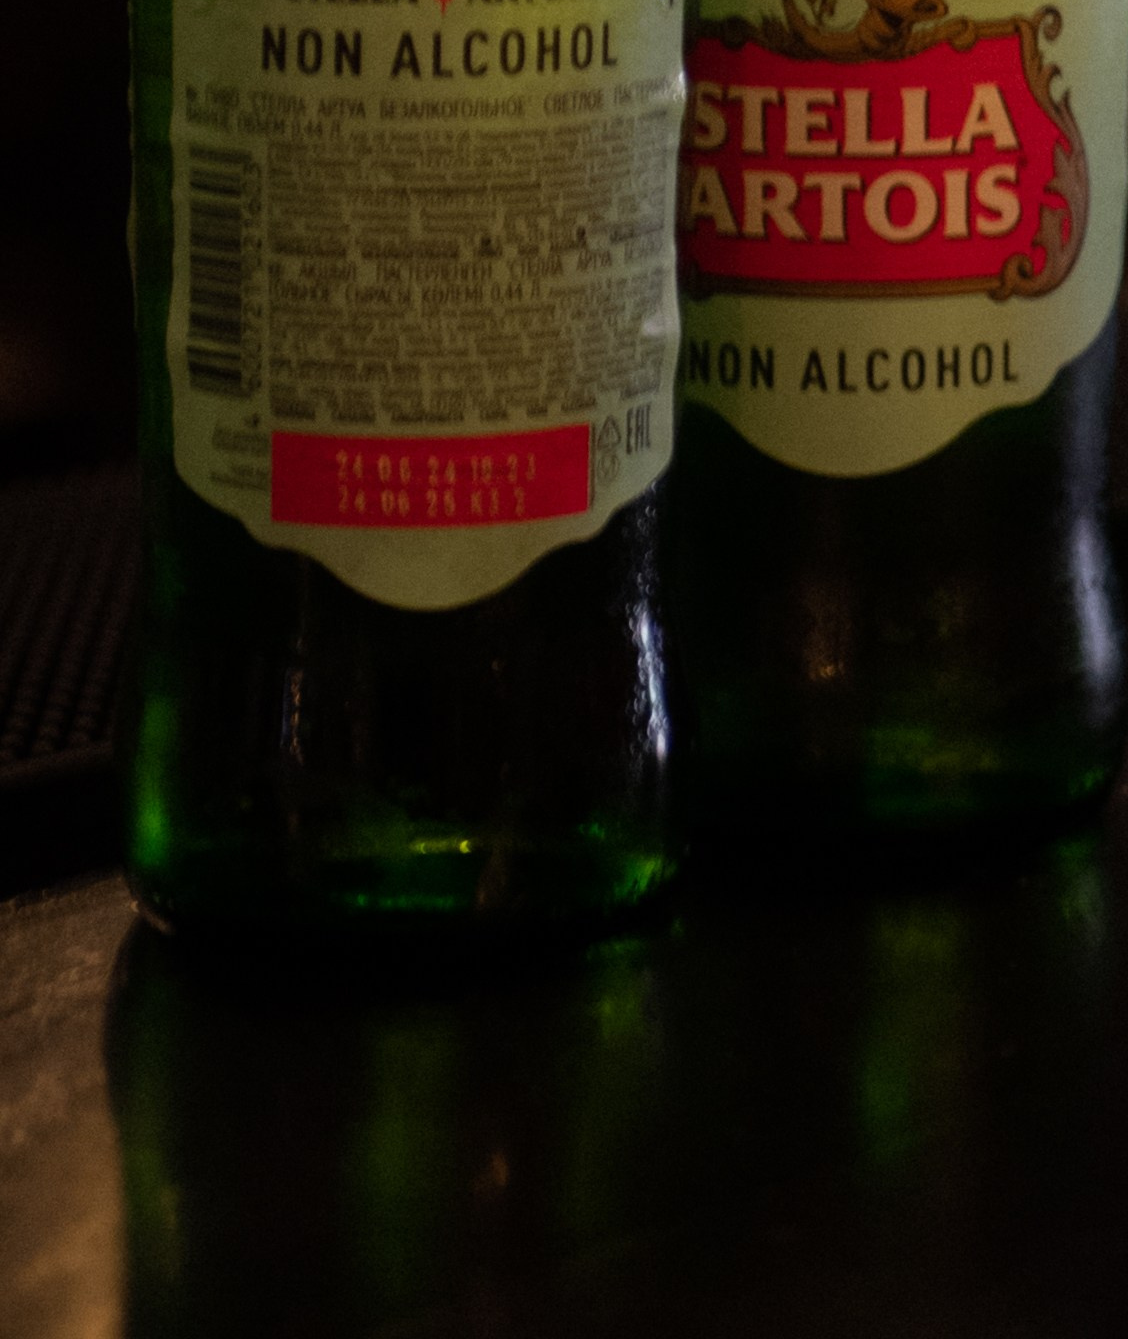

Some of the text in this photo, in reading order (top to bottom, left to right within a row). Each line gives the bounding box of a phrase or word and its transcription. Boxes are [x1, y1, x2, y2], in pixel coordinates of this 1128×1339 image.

[261, 20, 618, 79] NON ALCOHOL
[688, 81, 1020, 158] STELLA
[685, 163, 1022, 244] ARTOIS
[686, 338, 777, 389] NON
[801, 340, 1018, 393] ALCOHOL
